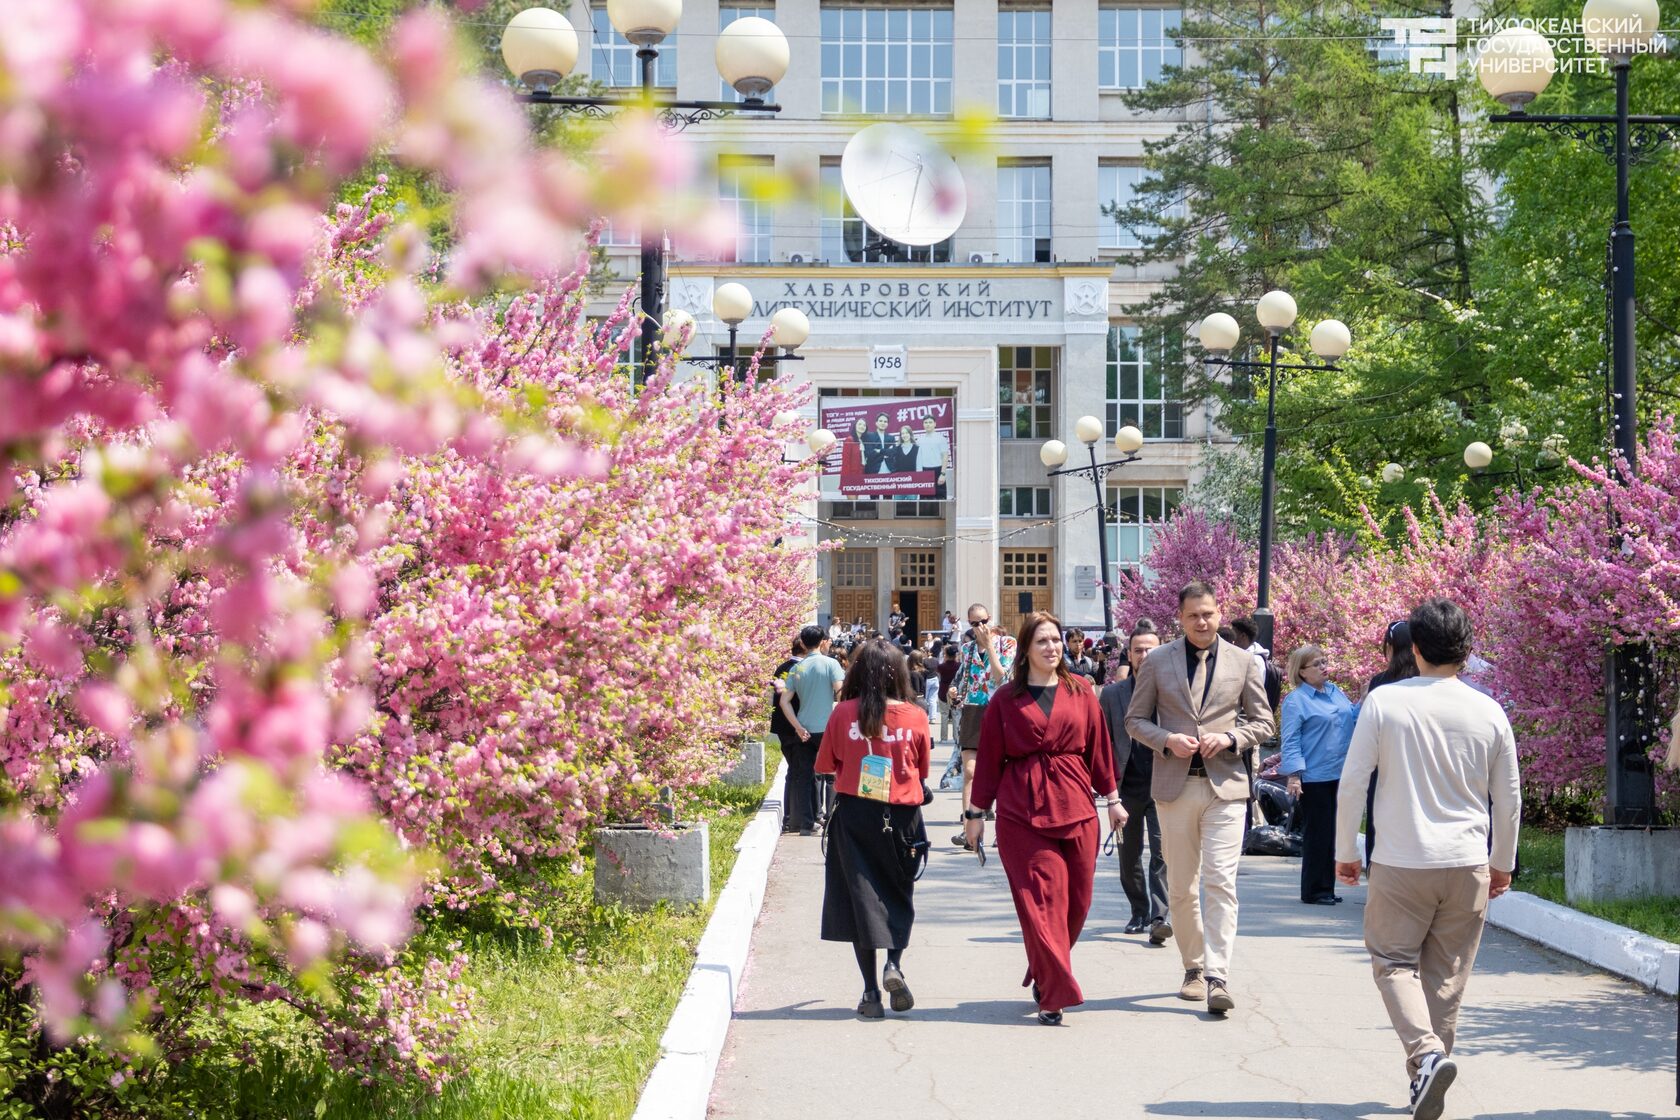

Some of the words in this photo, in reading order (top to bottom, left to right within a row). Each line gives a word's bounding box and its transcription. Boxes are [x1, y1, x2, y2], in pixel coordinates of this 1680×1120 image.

[784, 280, 990, 297] ХАБАРОВСКИЙ
[751, 298, 931, 318] ЛИТЕХНИЧЕСКИЙ
[943, 300, 1052, 319] ИНСТИТУТ
[874, 356, 902, 369] 1958
[896, 403, 947, 422] #ТОГУ
[842, 482, 897, 492] ГОСУДАРСТВЕННЫЙ
[897, 482, 935, 490] УНИВЕРСИТЕТ
